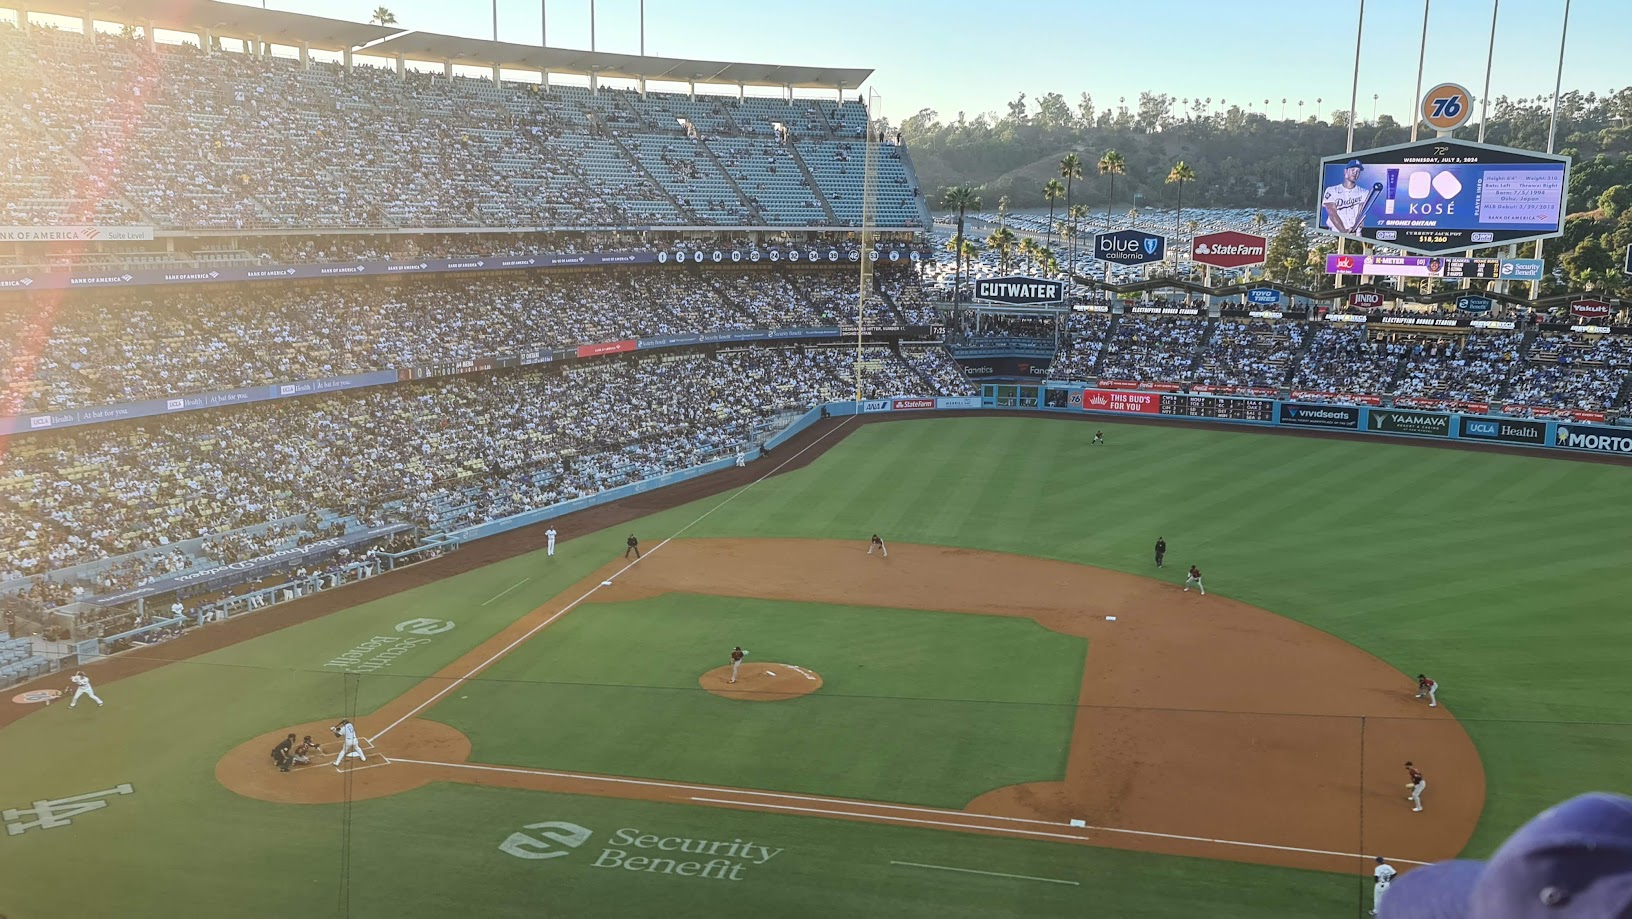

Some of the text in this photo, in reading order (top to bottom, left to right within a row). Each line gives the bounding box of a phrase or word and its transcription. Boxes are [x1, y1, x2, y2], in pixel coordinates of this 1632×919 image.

[1430, 96, 1462, 118] 76
[1409, 202, 1455, 215] KOSÉ
[18, 232, 30, 240] OF
[34, 232, 79, 240] AMERICA
[108, 232, 127, 240] Suite
[128, 232, 145, 240] Level
[1100, 235, 1140, 252] blue
[1210, 244, 1263, 256] StateFarm
[1106, 252, 1143, 260] california
[980, 282, 1056, 298] CUTWATER
[1354, 294, 1378, 304] JINRO
[1573, 304, 1608, 312] Yakult
[964, 366, 993, 375] Fanatics
[296, 384, 311, 392] Health
[185, 398, 203, 406] Health
[1070, 395, 1082, 403] 76
[1110, 394, 1150, 403] THIS BUD'S
[1127, 403, 1141, 411] YOU
[52, 416, 74, 424] Health
[1299, 409, 1349, 420] vividseats
[1470, 424, 1538, 438] UCLA Health
[175, 560, 254, 581] Dodgers
[323, 636, 402, 667] Benefit
[346, 637, 431, 673] Security
[608, 828, 784, 865] Security
[590, 848, 746, 881] Benefit
